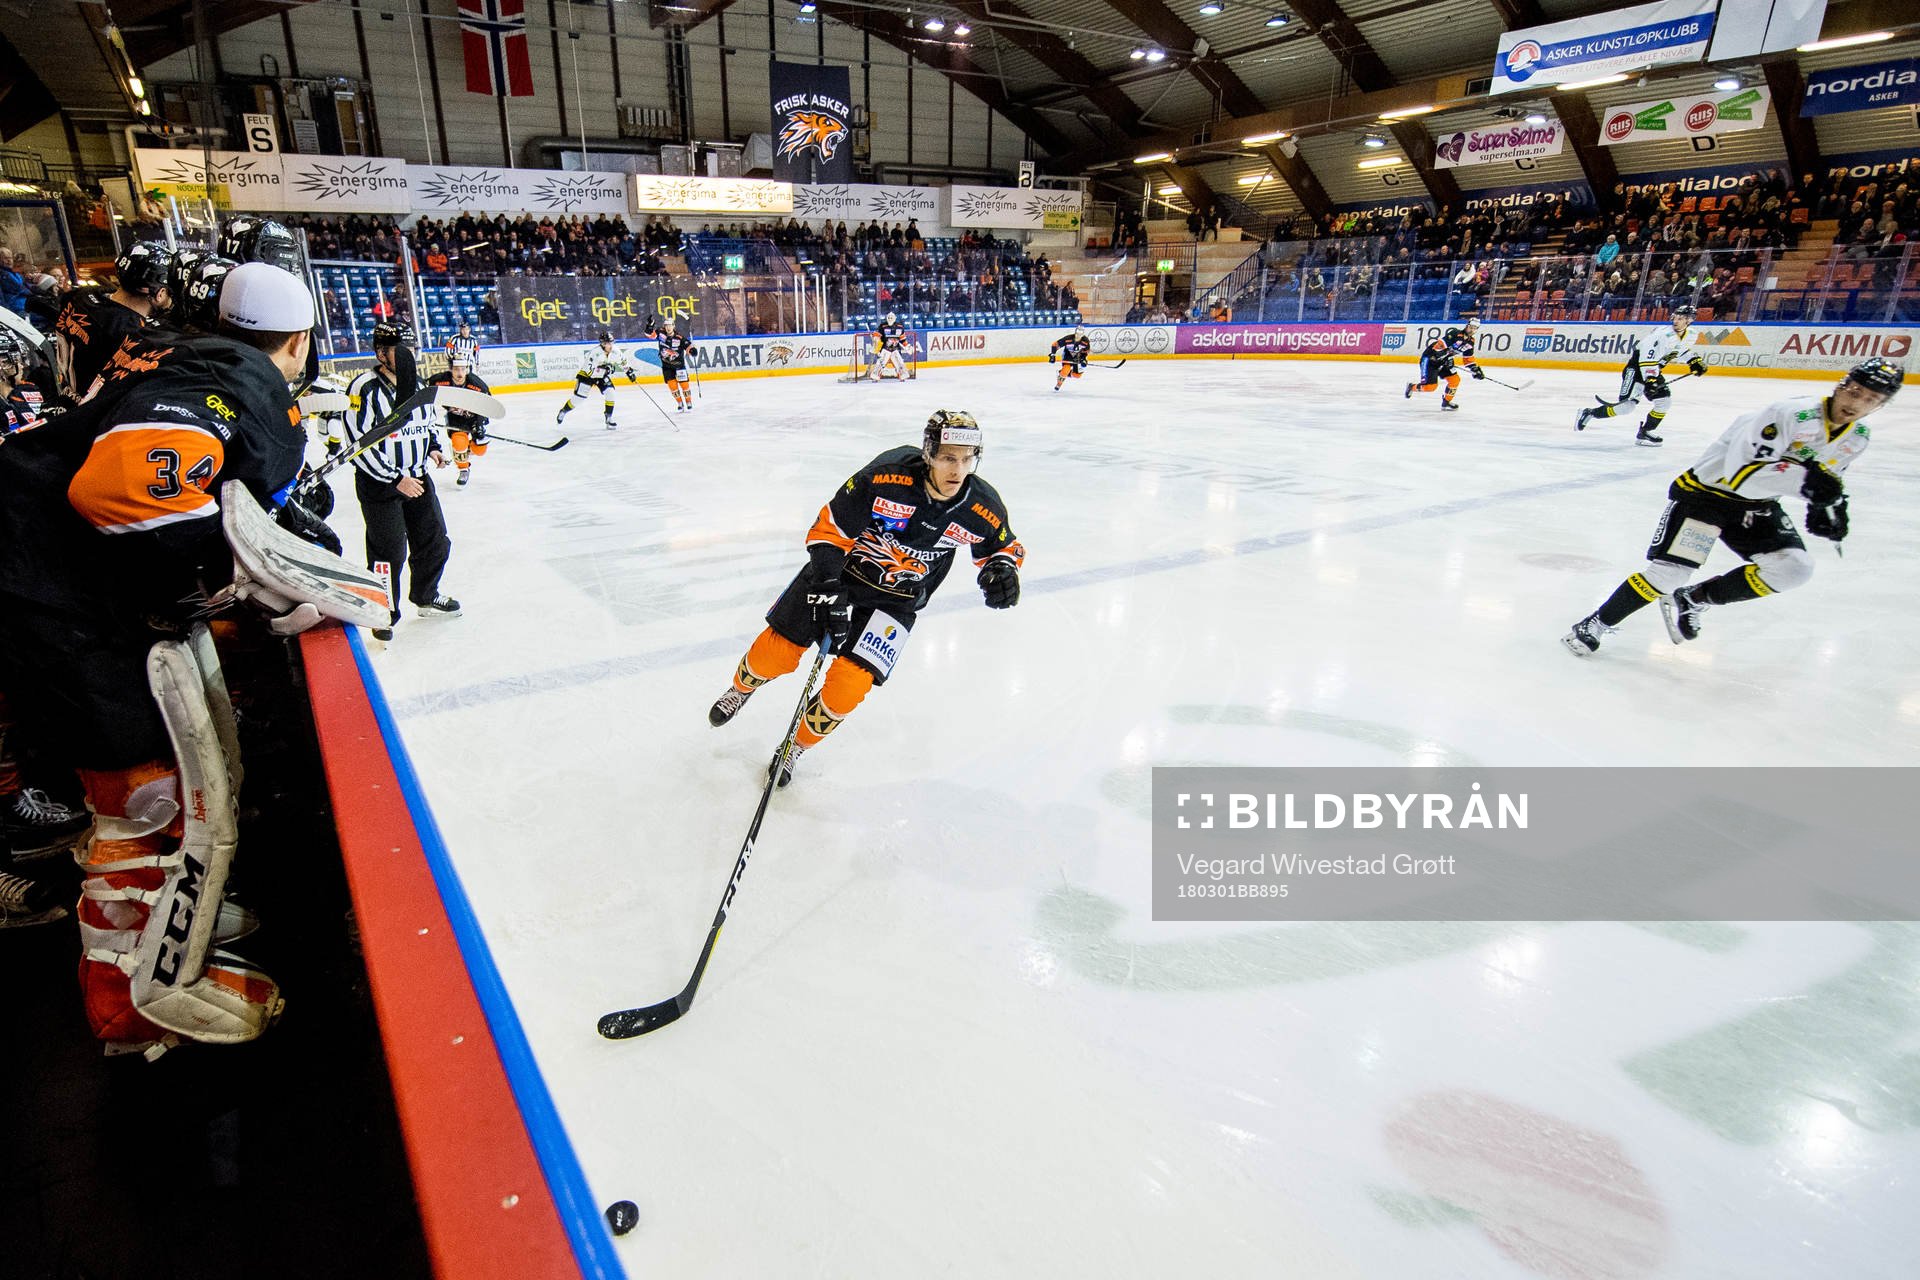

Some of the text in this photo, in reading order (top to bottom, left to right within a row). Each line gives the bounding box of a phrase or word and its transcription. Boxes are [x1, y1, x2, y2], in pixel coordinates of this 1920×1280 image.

[1546, 22, 1699, 62] ASKER KUNSTLØPKLUBB
[1868, 91, 1899, 102] ASKER
[774, 93, 849, 119] FRISK ASKER
[247, 116, 269, 126] FELT
[1690, 108, 1712, 123] RIIS
[1610, 119, 1631, 132] RIIS
[250, 127, 274, 153] S
[1691, 135, 1715, 151] D
[1479, 146, 1546, 162] superselma.no
[194, 171, 280, 187] energima
[330, 174, 407, 190] energima
[1382, 173, 1400, 186] C
[450, 182, 519, 198] energima
[559, 187, 622, 200] energima
[667, 189, 717, 200] energima
[745, 192, 791, 202] energima
[811, 196, 861, 208] energima
[889, 199, 935, 211] energima
[974, 200, 1017, 212] energima
[1041, 203, 1081, 213] energima
[226, 239, 240, 254] 17
[1192, 327, 1367, 351] asker treningssenter
[1384, 335, 1403, 346] 1881
[1525, 337, 1549, 348] 1881
[148, 448, 214, 499] 34
[872, 474, 914, 486] MAXXIS
[876, 498, 914, 513] IKANO
[949, 524, 983, 542] IKANO
[862, 631, 896, 663] ARKEL
[150, 852, 205, 987] CCM
